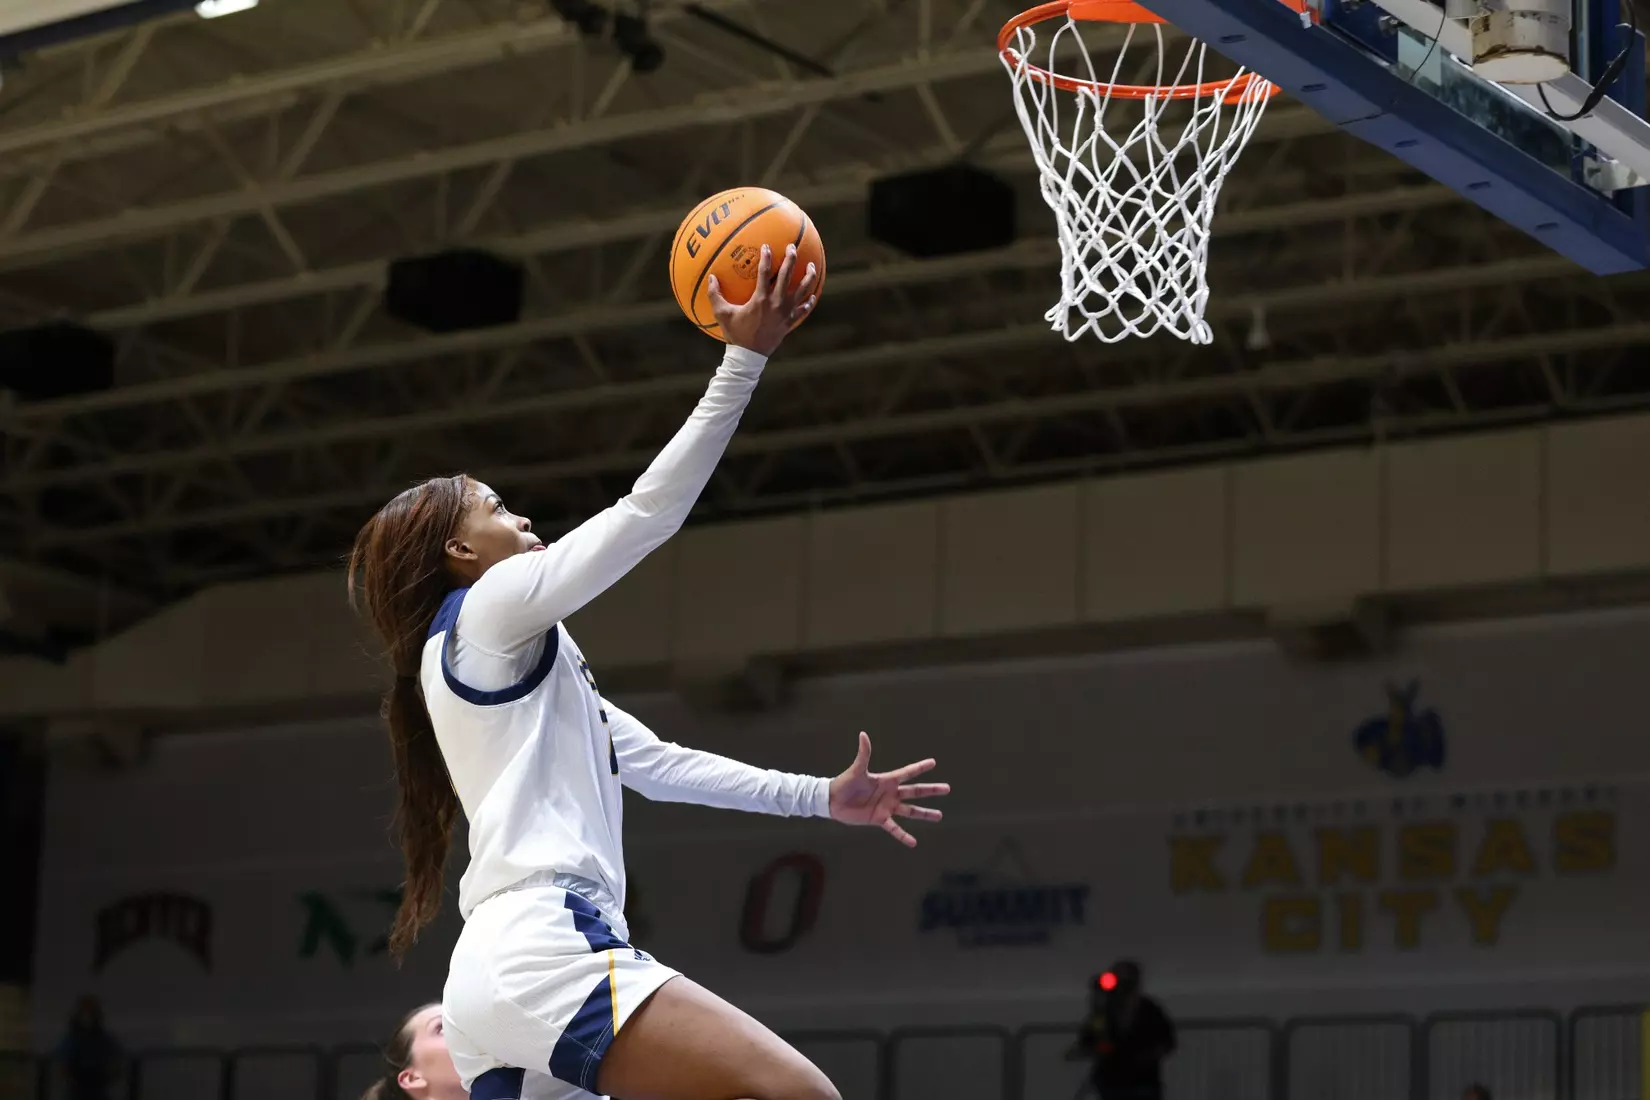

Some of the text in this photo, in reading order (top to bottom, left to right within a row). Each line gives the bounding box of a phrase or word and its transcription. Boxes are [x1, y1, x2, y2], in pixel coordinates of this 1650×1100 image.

[686, 202, 730, 259] EVO
[1167, 810, 1617, 894] KANSAS
[917, 883, 1090, 933] SUMMIT
[1259, 884, 1519, 954] CITY
